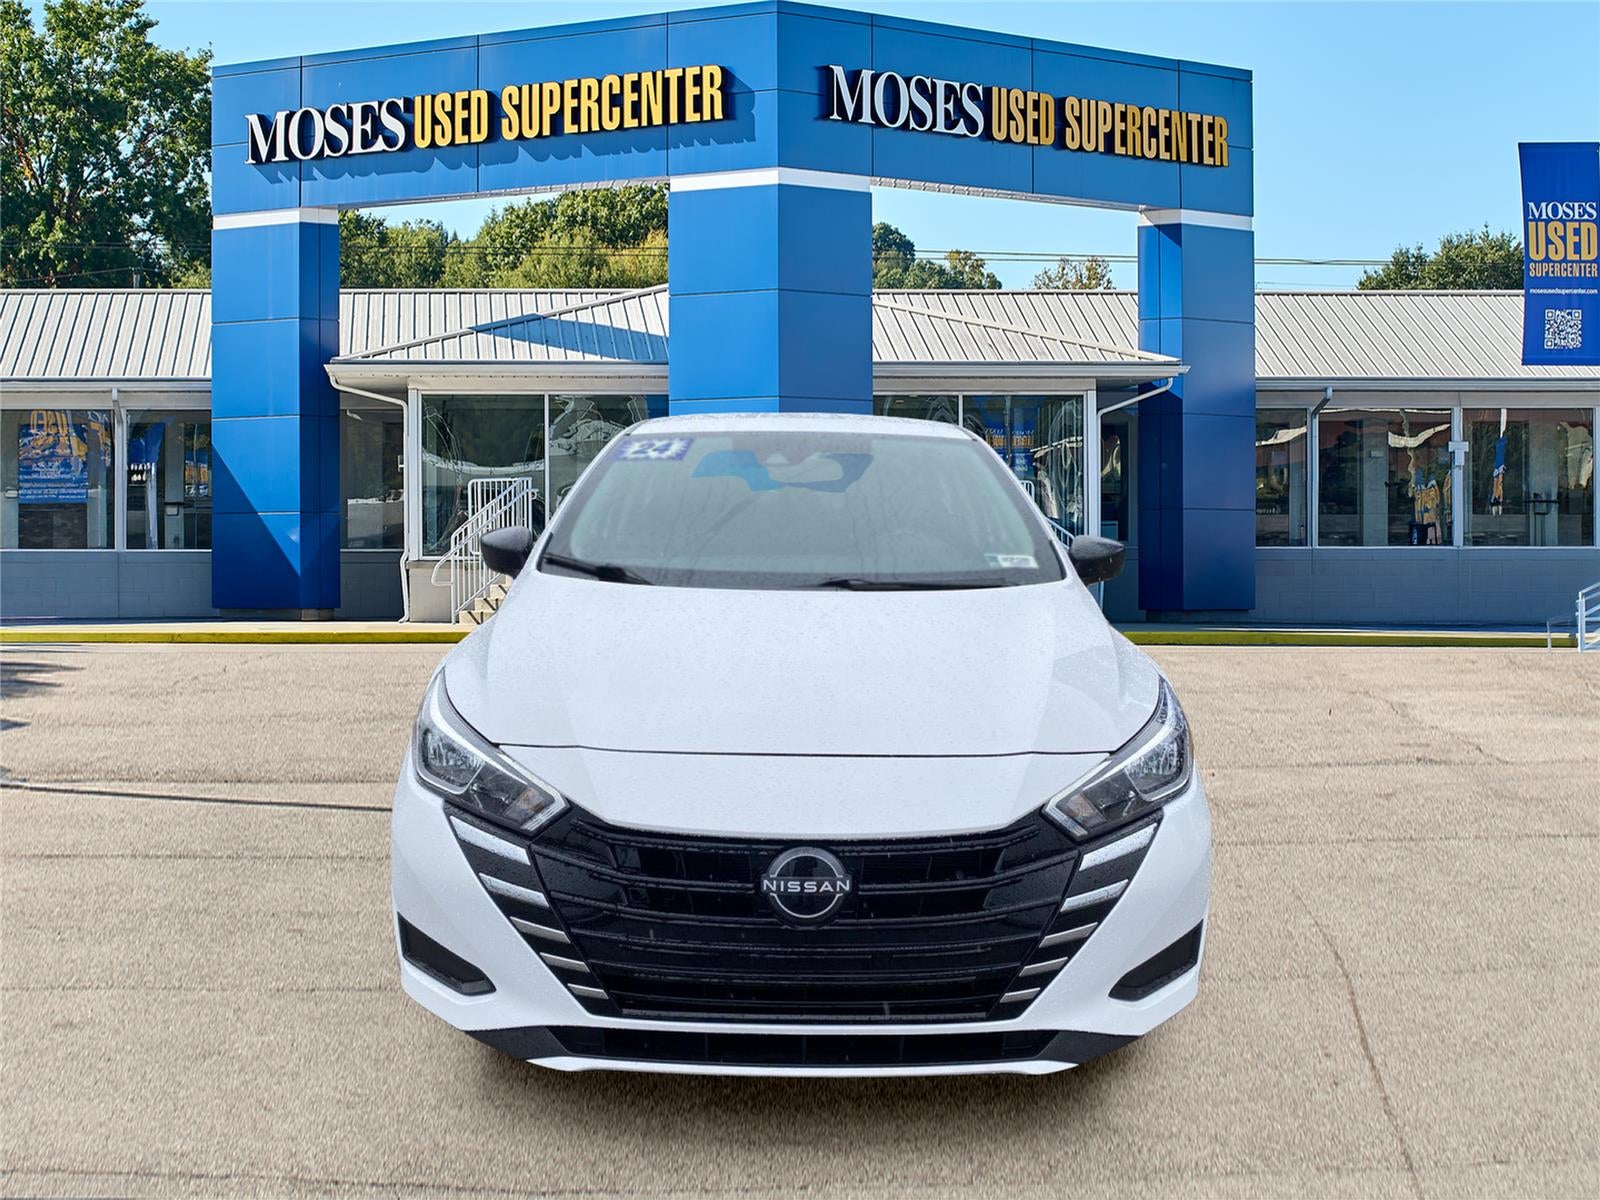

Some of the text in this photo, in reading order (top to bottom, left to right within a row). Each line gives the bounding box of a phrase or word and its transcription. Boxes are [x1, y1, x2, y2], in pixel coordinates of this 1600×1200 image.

[245, 65, 723, 165] MOSES USED SUPERCENTER
[829, 65, 1229, 167] MOSES USED SUPERCENTER
[1528, 201, 1597, 220] MOSES
[1528, 221, 1598, 261] USED
[1529, 262, 1598, 278] SUPERCENTER
[622, 439, 686, 460] 24
[763, 879, 850, 893] NISSAN
